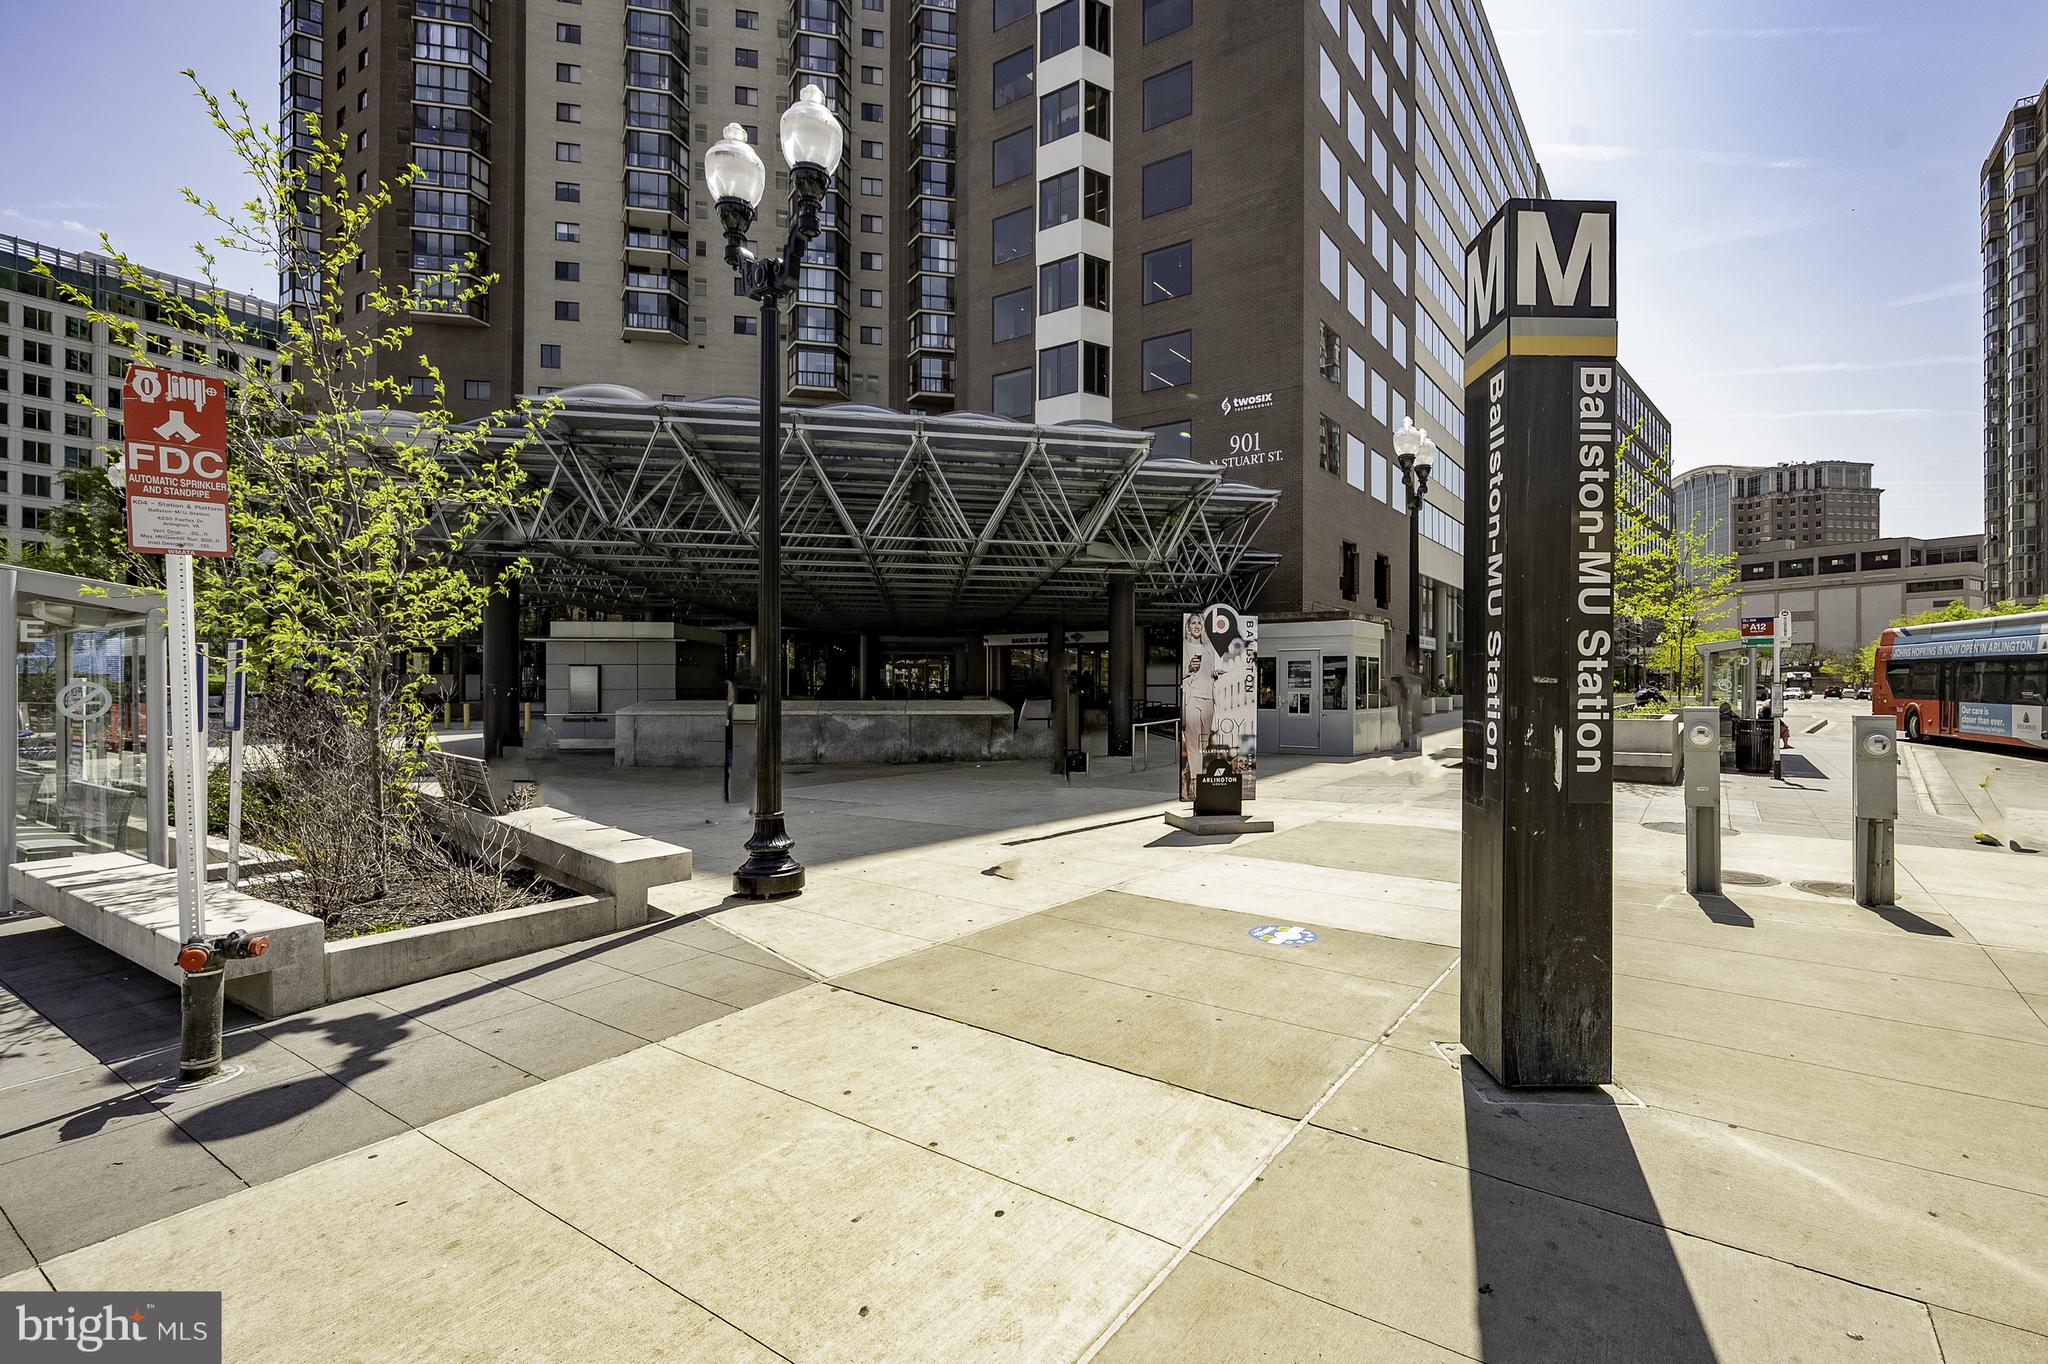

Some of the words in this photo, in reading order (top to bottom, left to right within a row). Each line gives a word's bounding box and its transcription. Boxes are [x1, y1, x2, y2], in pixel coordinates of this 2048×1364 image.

[1516, 210, 1610, 307] M
[1467, 215, 1505, 342] M
[1233, 392, 1272, 407] twosix
[1230, 432, 1261, 455] 901
[128, 442, 223, 479] FDC
[1221, 453, 1265, 467] STUART
[1267, 450, 1283, 462] ST.
[128, 473, 178, 487] AUTOMATIC
[180, 479, 227, 491] SPRINKLER
[1577, 367, 1612, 615] Ballston-MU
[143, 485, 162, 494] AND
[163, 486, 210, 498] STANDPIPE
[1487, 370, 1505, 617] Ballston-MU
[158, 501, 184, 509] Station
[20, 620, 46, 643] E
[1749, 623, 1767, 631] A12
[1893, 648, 1911, 658] JOHNS
[1912, 646, 1936, 657] HOPKINS
[1937, 646, 1944, 656] IS
[1944, 643, 1960, 655] NOW
[1960, 642, 1978, 654] OPEN
[1979, 642, 1988, 652] IN
[1988, 640, 2035, 653] ARLINGTON.
[1740, 656, 1750, 666] D
[1486, 630, 1502, 770] Station
[1576, 629, 1612, 773] Station
[1961, 705, 1972, 714] Our
[1983, 707, 1989, 716] is
[1961, 715, 1977, 724] closer
[1977, 716, 1990, 725] than
[1990, 719, 2005, 727] ever.
